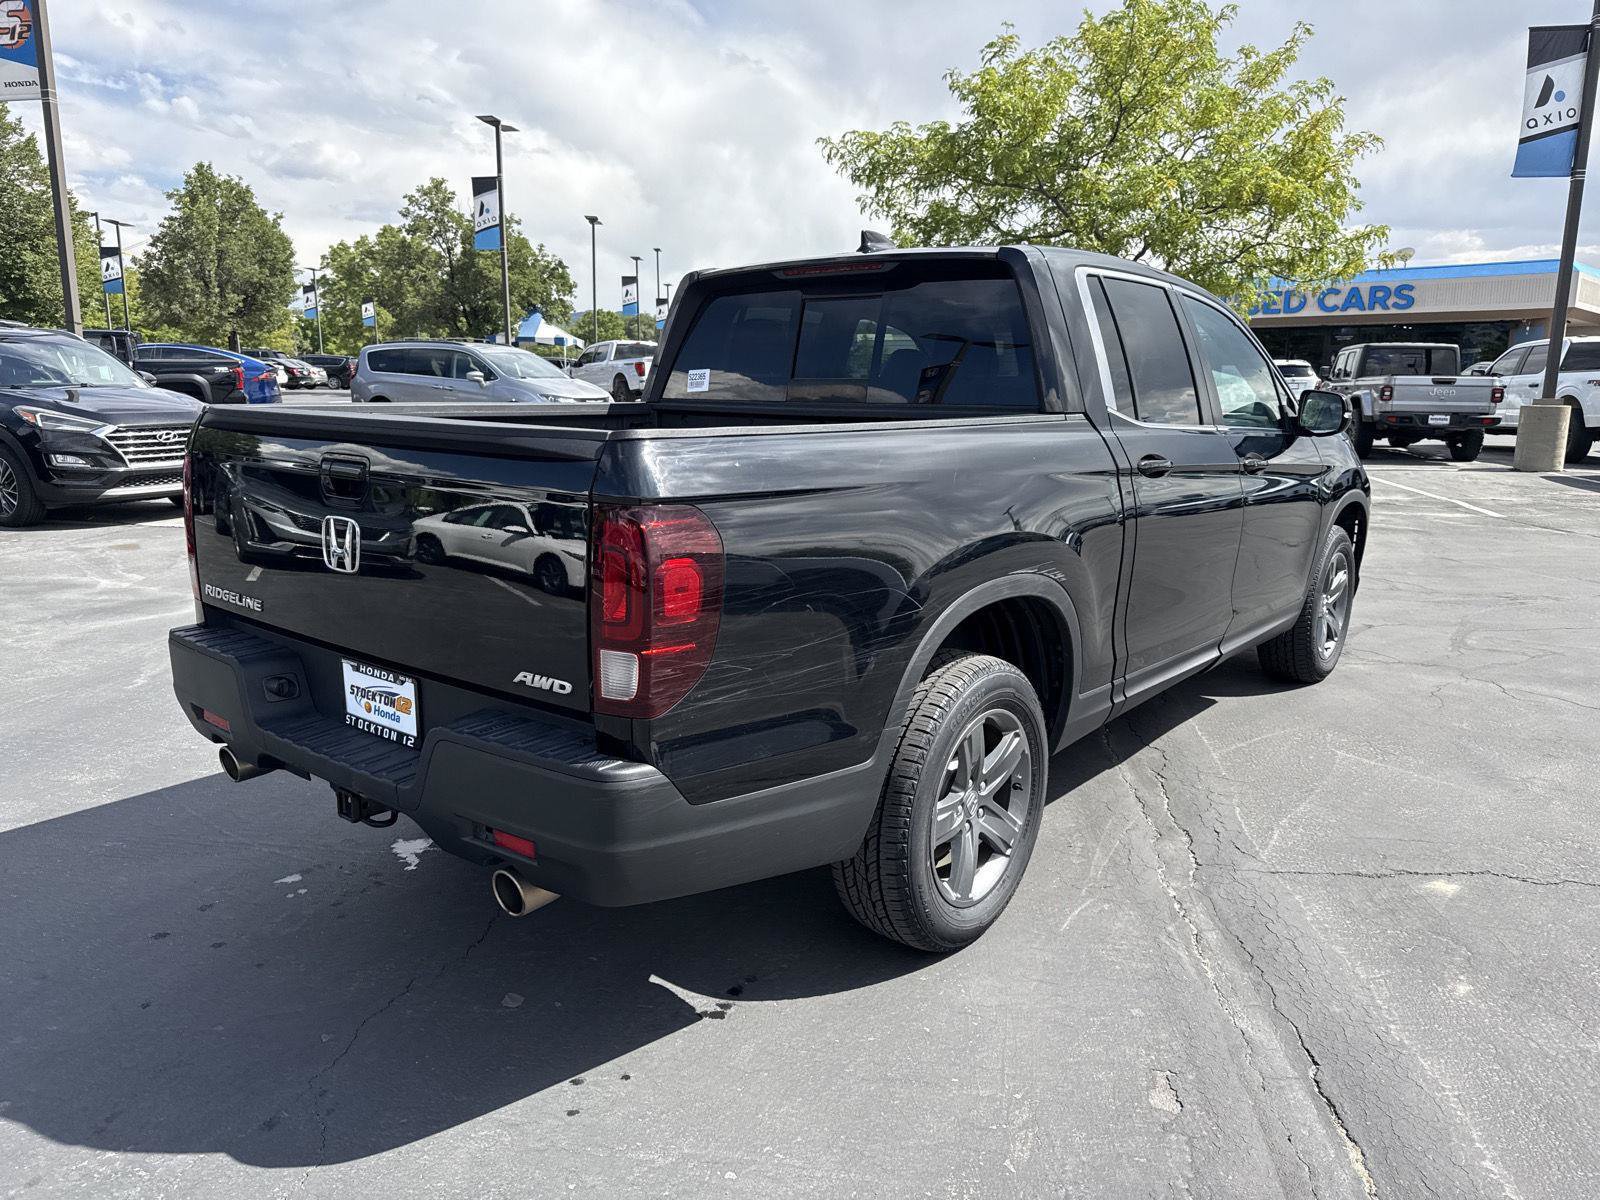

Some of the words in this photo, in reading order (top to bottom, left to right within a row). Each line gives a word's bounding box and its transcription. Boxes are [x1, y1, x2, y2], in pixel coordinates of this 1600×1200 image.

[4, 80, 38, 88] HONDA
[1317, 284, 1415, 312] CARS
[1429, 387, 1456, 397] Jeep
[205, 583, 264, 612] RIDGELINE
[359, 664, 395, 683] HONDA
[512, 671, 573, 695] AWD
[349, 684, 397, 709] STOCKTON
[395, 695, 413, 715] 12
[373, 704, 401, 724] Honda
[345, 714, 397, 741] STOCKTON
[402, 735, 415, 748] 12
